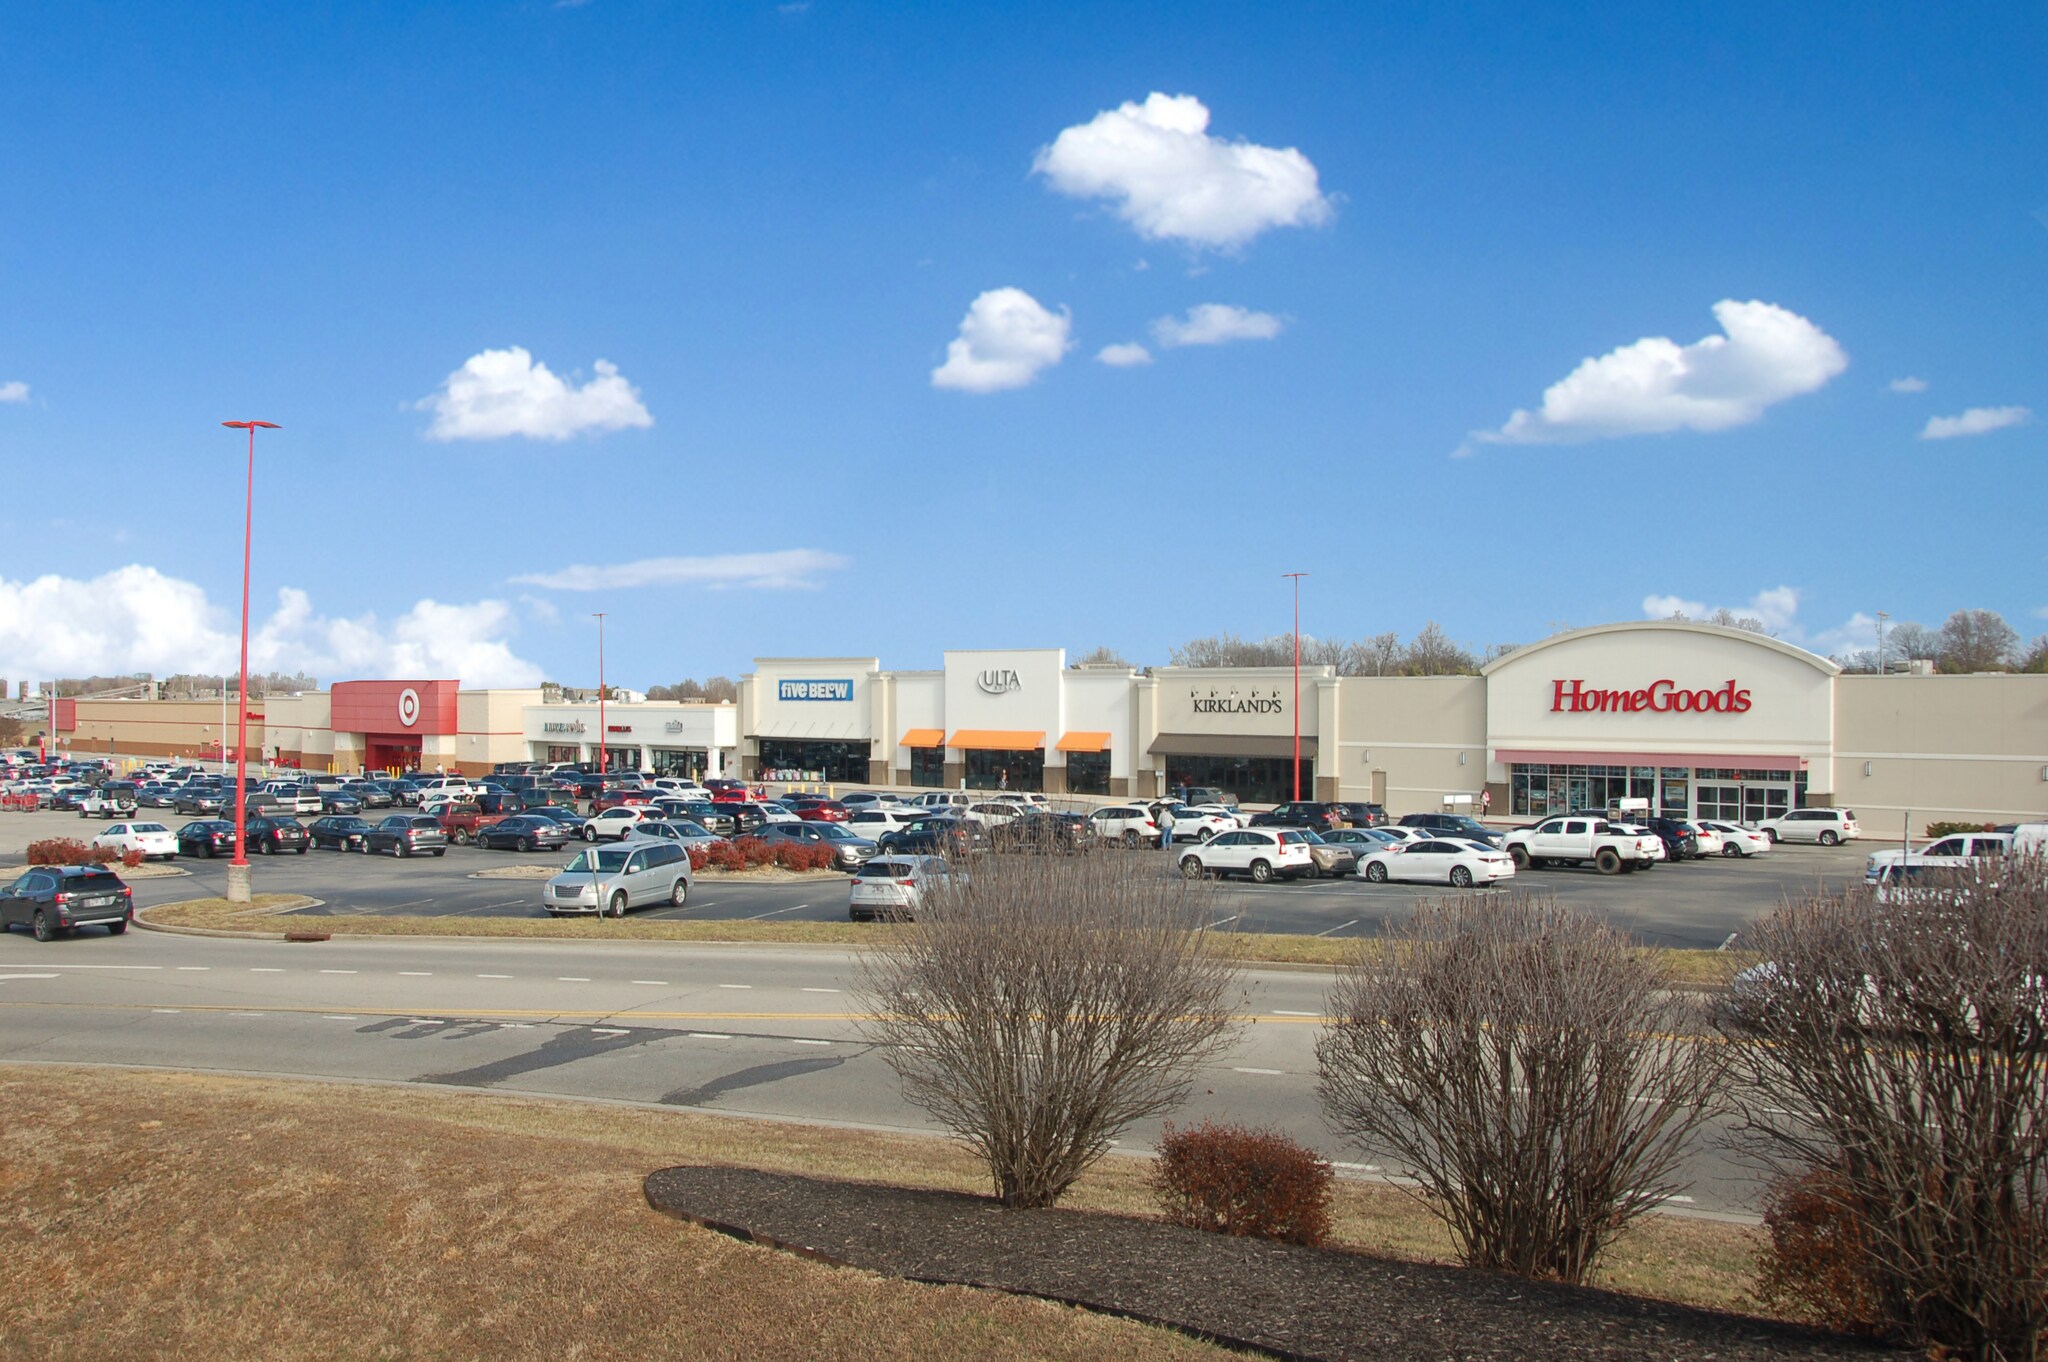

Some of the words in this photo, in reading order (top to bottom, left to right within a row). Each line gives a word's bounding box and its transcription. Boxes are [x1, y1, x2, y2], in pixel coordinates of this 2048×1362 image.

[983, 669, 1021, 686] ULTA
[1550, 678, 1752, 713] HomeGoods
[1193, 699, 1283, 714] KIRKLAND'S
